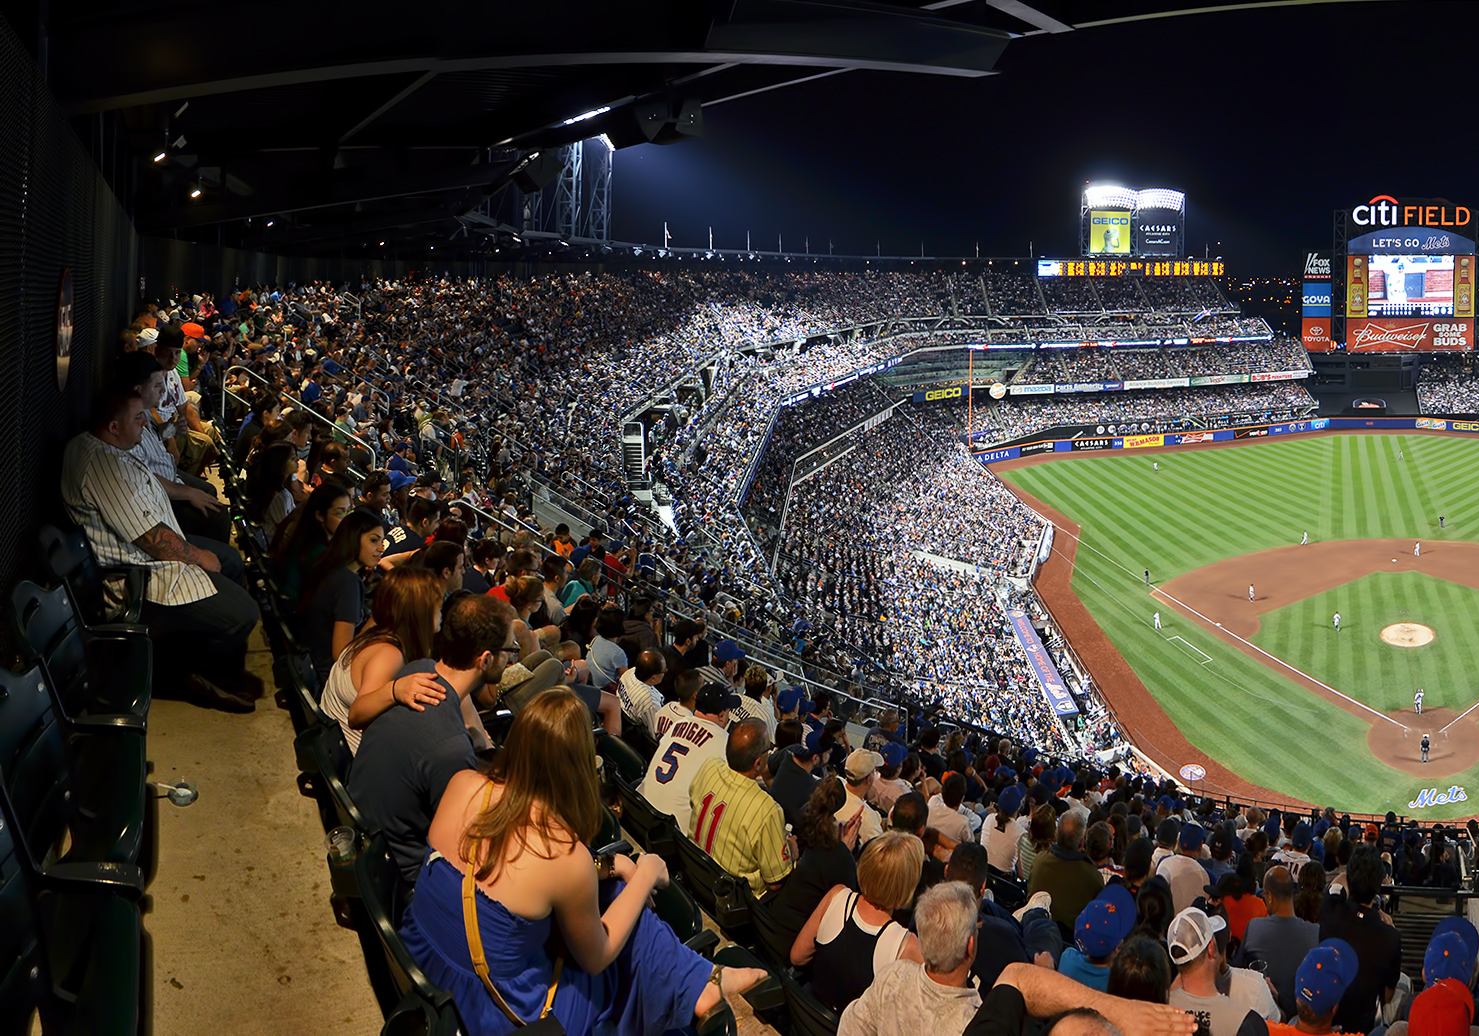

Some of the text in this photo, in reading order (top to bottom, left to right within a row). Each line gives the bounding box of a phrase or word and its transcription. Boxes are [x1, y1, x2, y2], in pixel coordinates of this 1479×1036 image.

[1404, 206, 1470, 225] FIELD
[1373, 235, 1450, 250] LET'S GO Mets
[1303, 296, 1330, 304] GOYA
[1433, 324, 1467, 332] GRAB
[1353, 329, 1427, 342] Budweiser
[1433, 337, 1467, 346] BUDS
[926, 387, 961, 401] GEICO
[985, 451, 1009, 460] DELTA
[671, 721, 713, 747] WRIGHT
[656, 741, 690, 784] 5
[1408, 785, 1468, 808] Mets
[695, 791, 727, 856] 11
